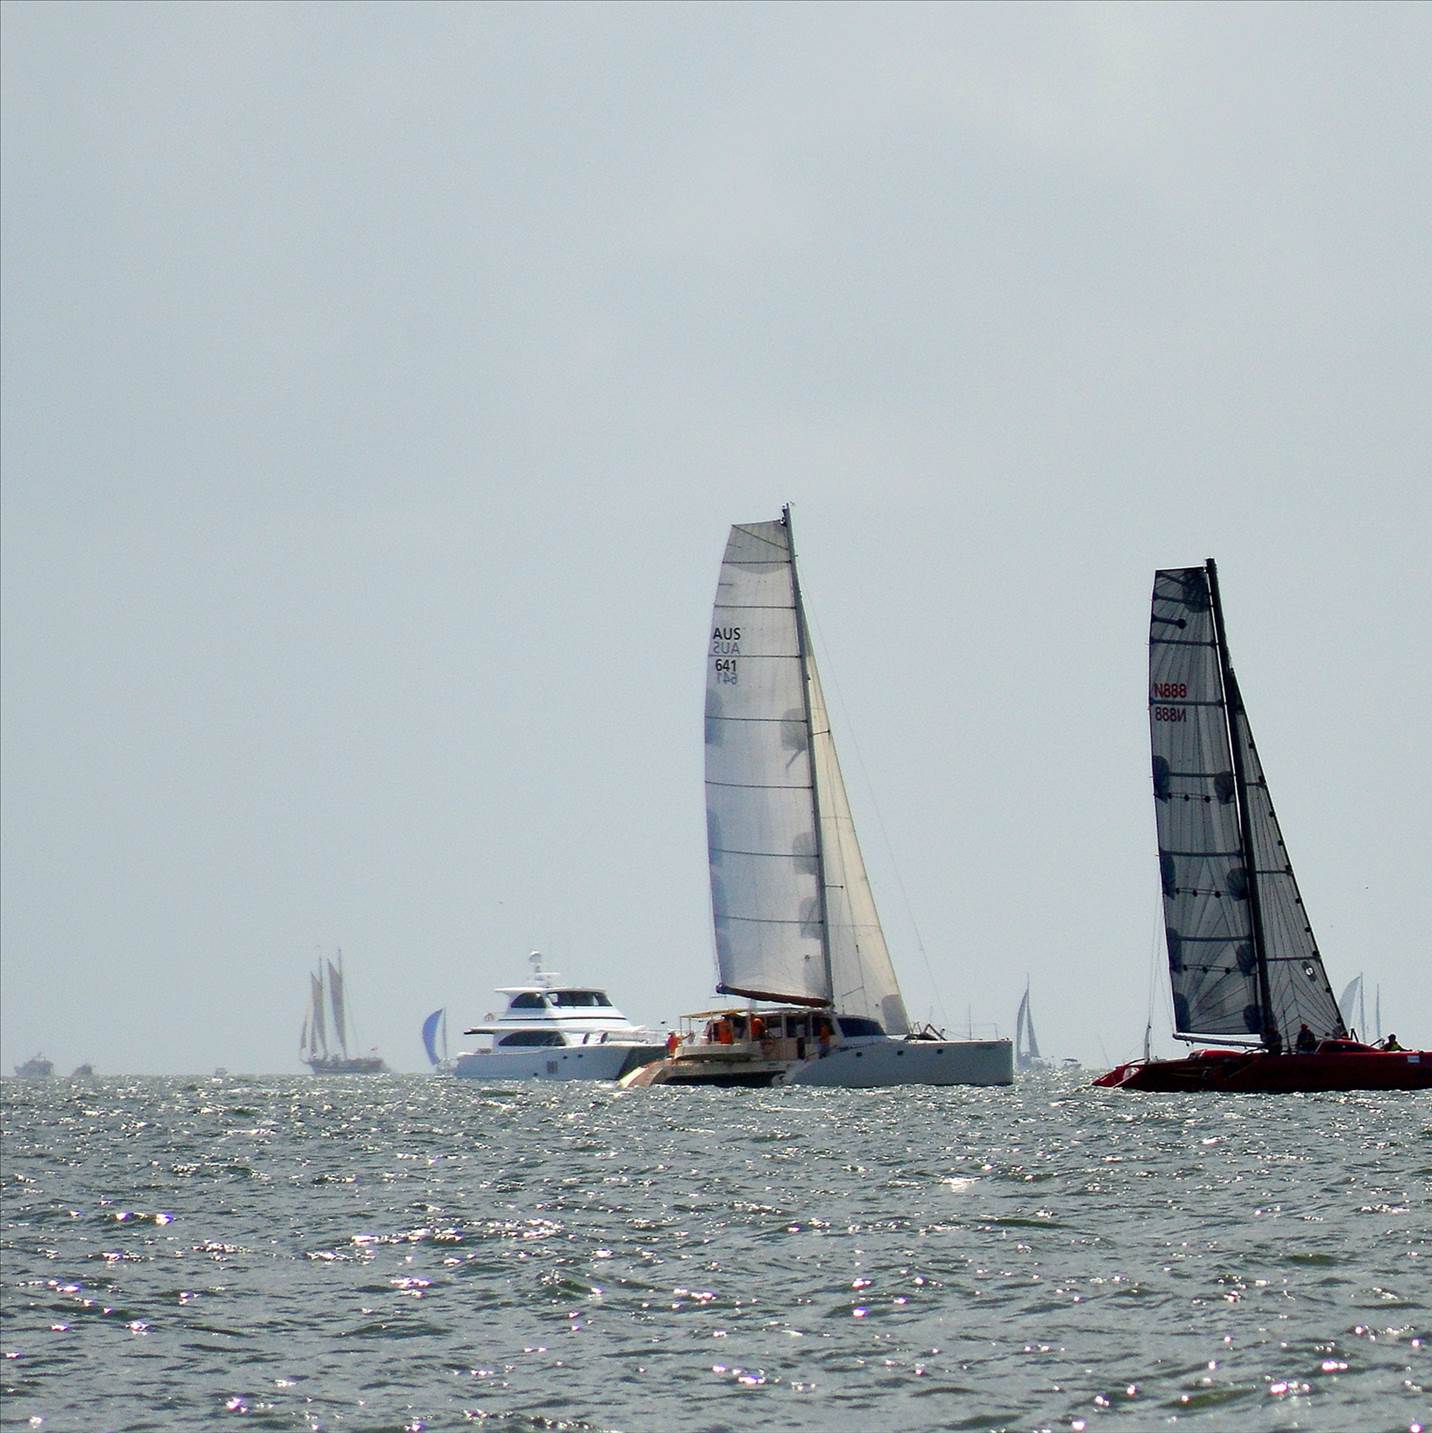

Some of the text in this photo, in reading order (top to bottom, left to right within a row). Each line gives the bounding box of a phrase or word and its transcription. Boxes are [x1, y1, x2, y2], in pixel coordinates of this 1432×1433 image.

[713, 627, 741, 640] AUS
[715, 659, 736, 671] 641
[1152, 683, 1187, 698] N888
